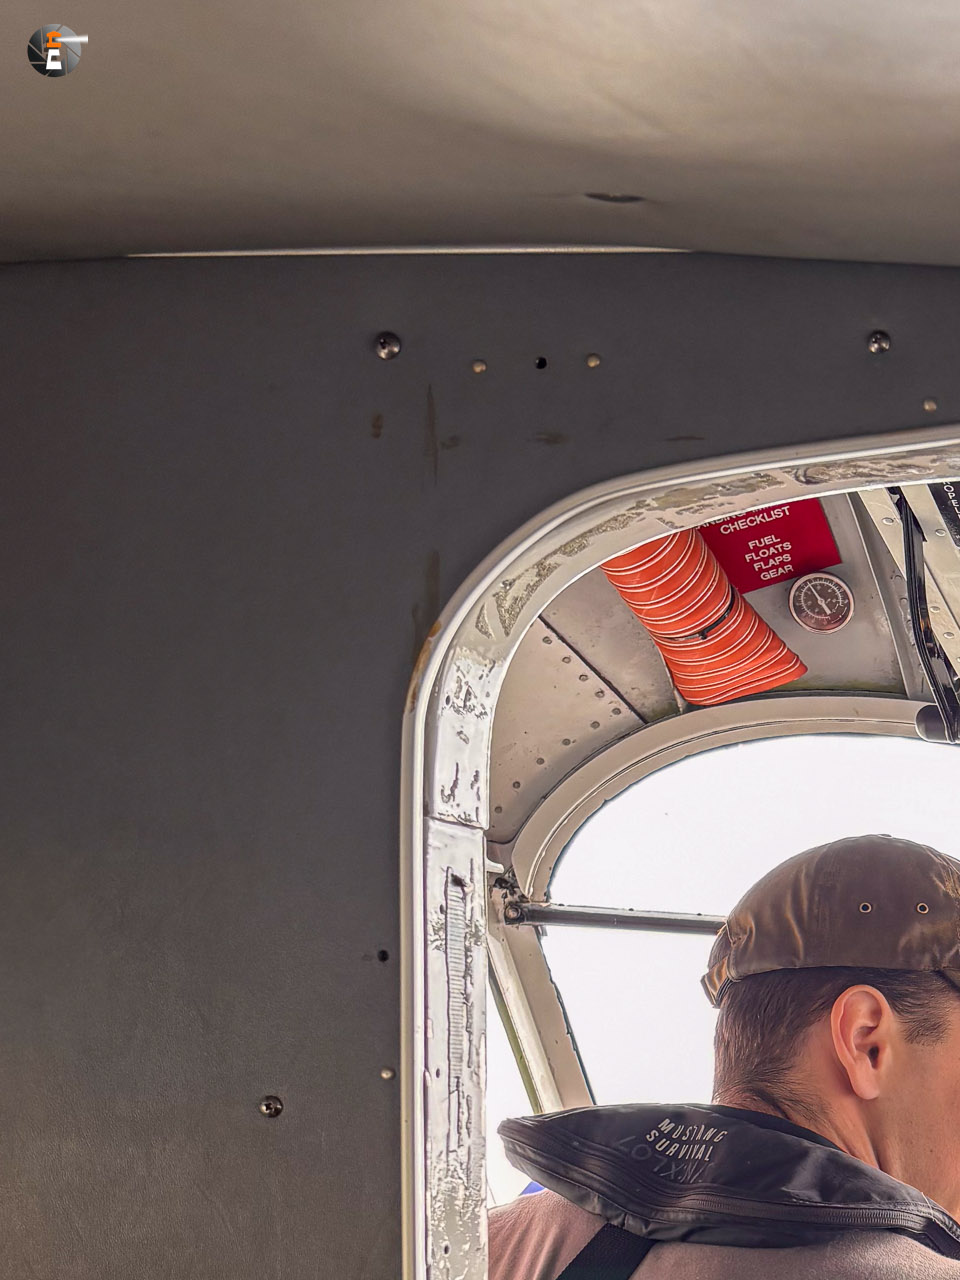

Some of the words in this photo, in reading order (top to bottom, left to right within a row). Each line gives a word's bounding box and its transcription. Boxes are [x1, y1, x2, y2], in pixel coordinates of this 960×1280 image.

[720, 506, 790, 534] CHECKLIST
[744, 542, 792, 562] FLOATS
[748, 534, 780, 550] FUEL
[753, 554, 792, 572] FLAPS
[760, 564, 794, 580] GEAR
[658, 1118, 728, 1142] MUSTANG
[645, 1129, 714, 1162] SURVIVAL
